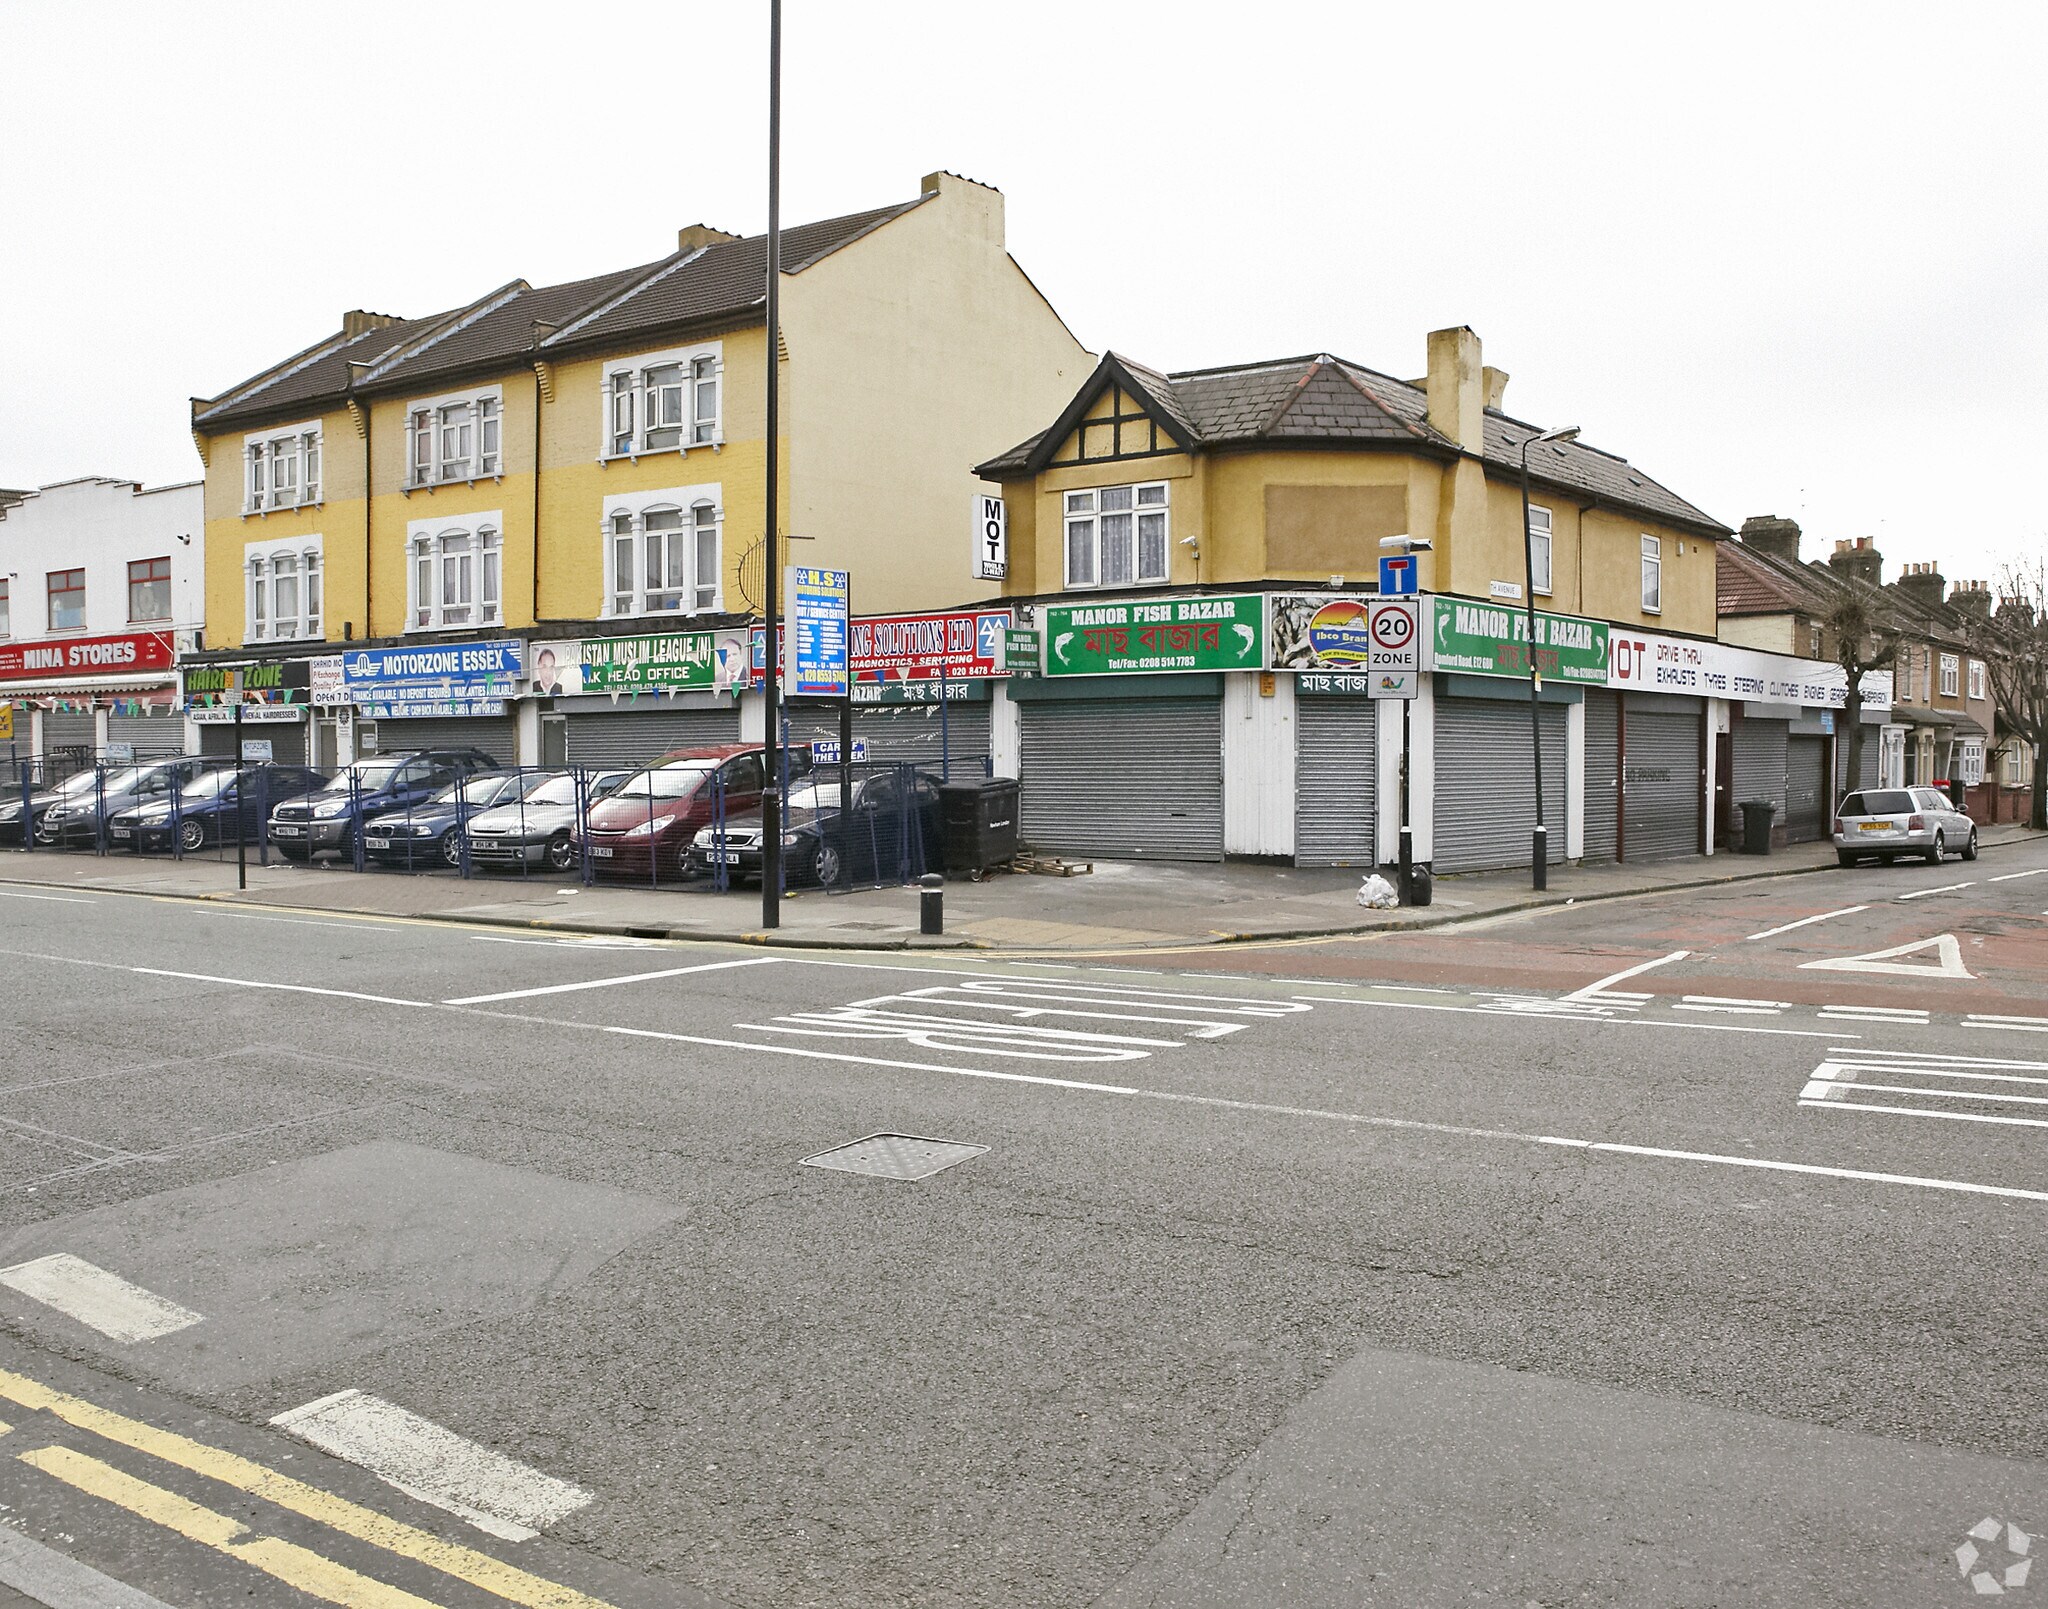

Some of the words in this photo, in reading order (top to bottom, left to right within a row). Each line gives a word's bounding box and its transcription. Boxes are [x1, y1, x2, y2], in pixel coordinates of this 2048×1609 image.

[985, 499, 1000, 560] MOT
[1071, 607, 1127, 626] MANOR
[1133, 605, 1171, 622] FISH
[1178, 601, 1235, 621] BAZAR
[1316, 632, 1339, 641] Ibco
[1342, 633, 1368, 642] Bran
[1379, 619, 1408, 636] 20
[1455, 606, 1508, 639] MANOR
[1513, 614, 1545, 644] FIH
[1550, 620, 1592, 650] BAZAR
[850, 625, 872, 657] ING
[874, 620, 944, 656] SOLUTIONS
[948, 618, 974, 652] LTD
[1083, 627, 1131, 655] মাছ
[1138, 622, 1222, 654] বাজার
[24, 647, 64, 670] MINA
[69, 641, 136, 667] STORES
[614, 640, 649, 666] MUSLIM
[653, 638, 692, 664] LEAGUE
[919, 654, 973, 666] SERVICING
[1373, 653, 1412, 664] ZONE
[1657, 644, 1679, 662] DRIVE
[1683, 648, 1702, 665] THRU
[384, 652, 459, 675] MOTORZONE
[462, 649, 504, 672] ESSEX
[952, 667, 966, 676] 020
[969, 666, 988, 676] 8478
[1108, 658, 1139, 669] Tel/Fax:
[1139, 658, 1160, 668] 0208
[1161, 657, 1175, 667] 514
[1176, 656, 1195, 667] 7783
[244, 664, 282, 688] ZONE
[608, 669, 640, 682] HEAD
[648, 667, 690, 681] OFFICE
[1301, 674, 1331, 691] মাছ
[1657, 667, 1695, 686] EXHAUSTS
[1704, 673, 1726, 690] TYRES
[1734, 677, 1764, 694] STEERING
[1770, 681, 1798, 697] CLUTCHES
[1804, 685, 1825, 700] ENGINES
[316, 693, 335, 702] OPEN
[263, 710, 298, 720] HAIRDRESSERS
[820, 743, 840, 752] CAR
[815, 753, 833, 762] THE
[732, 981, 1312, 1061] CLEAR
